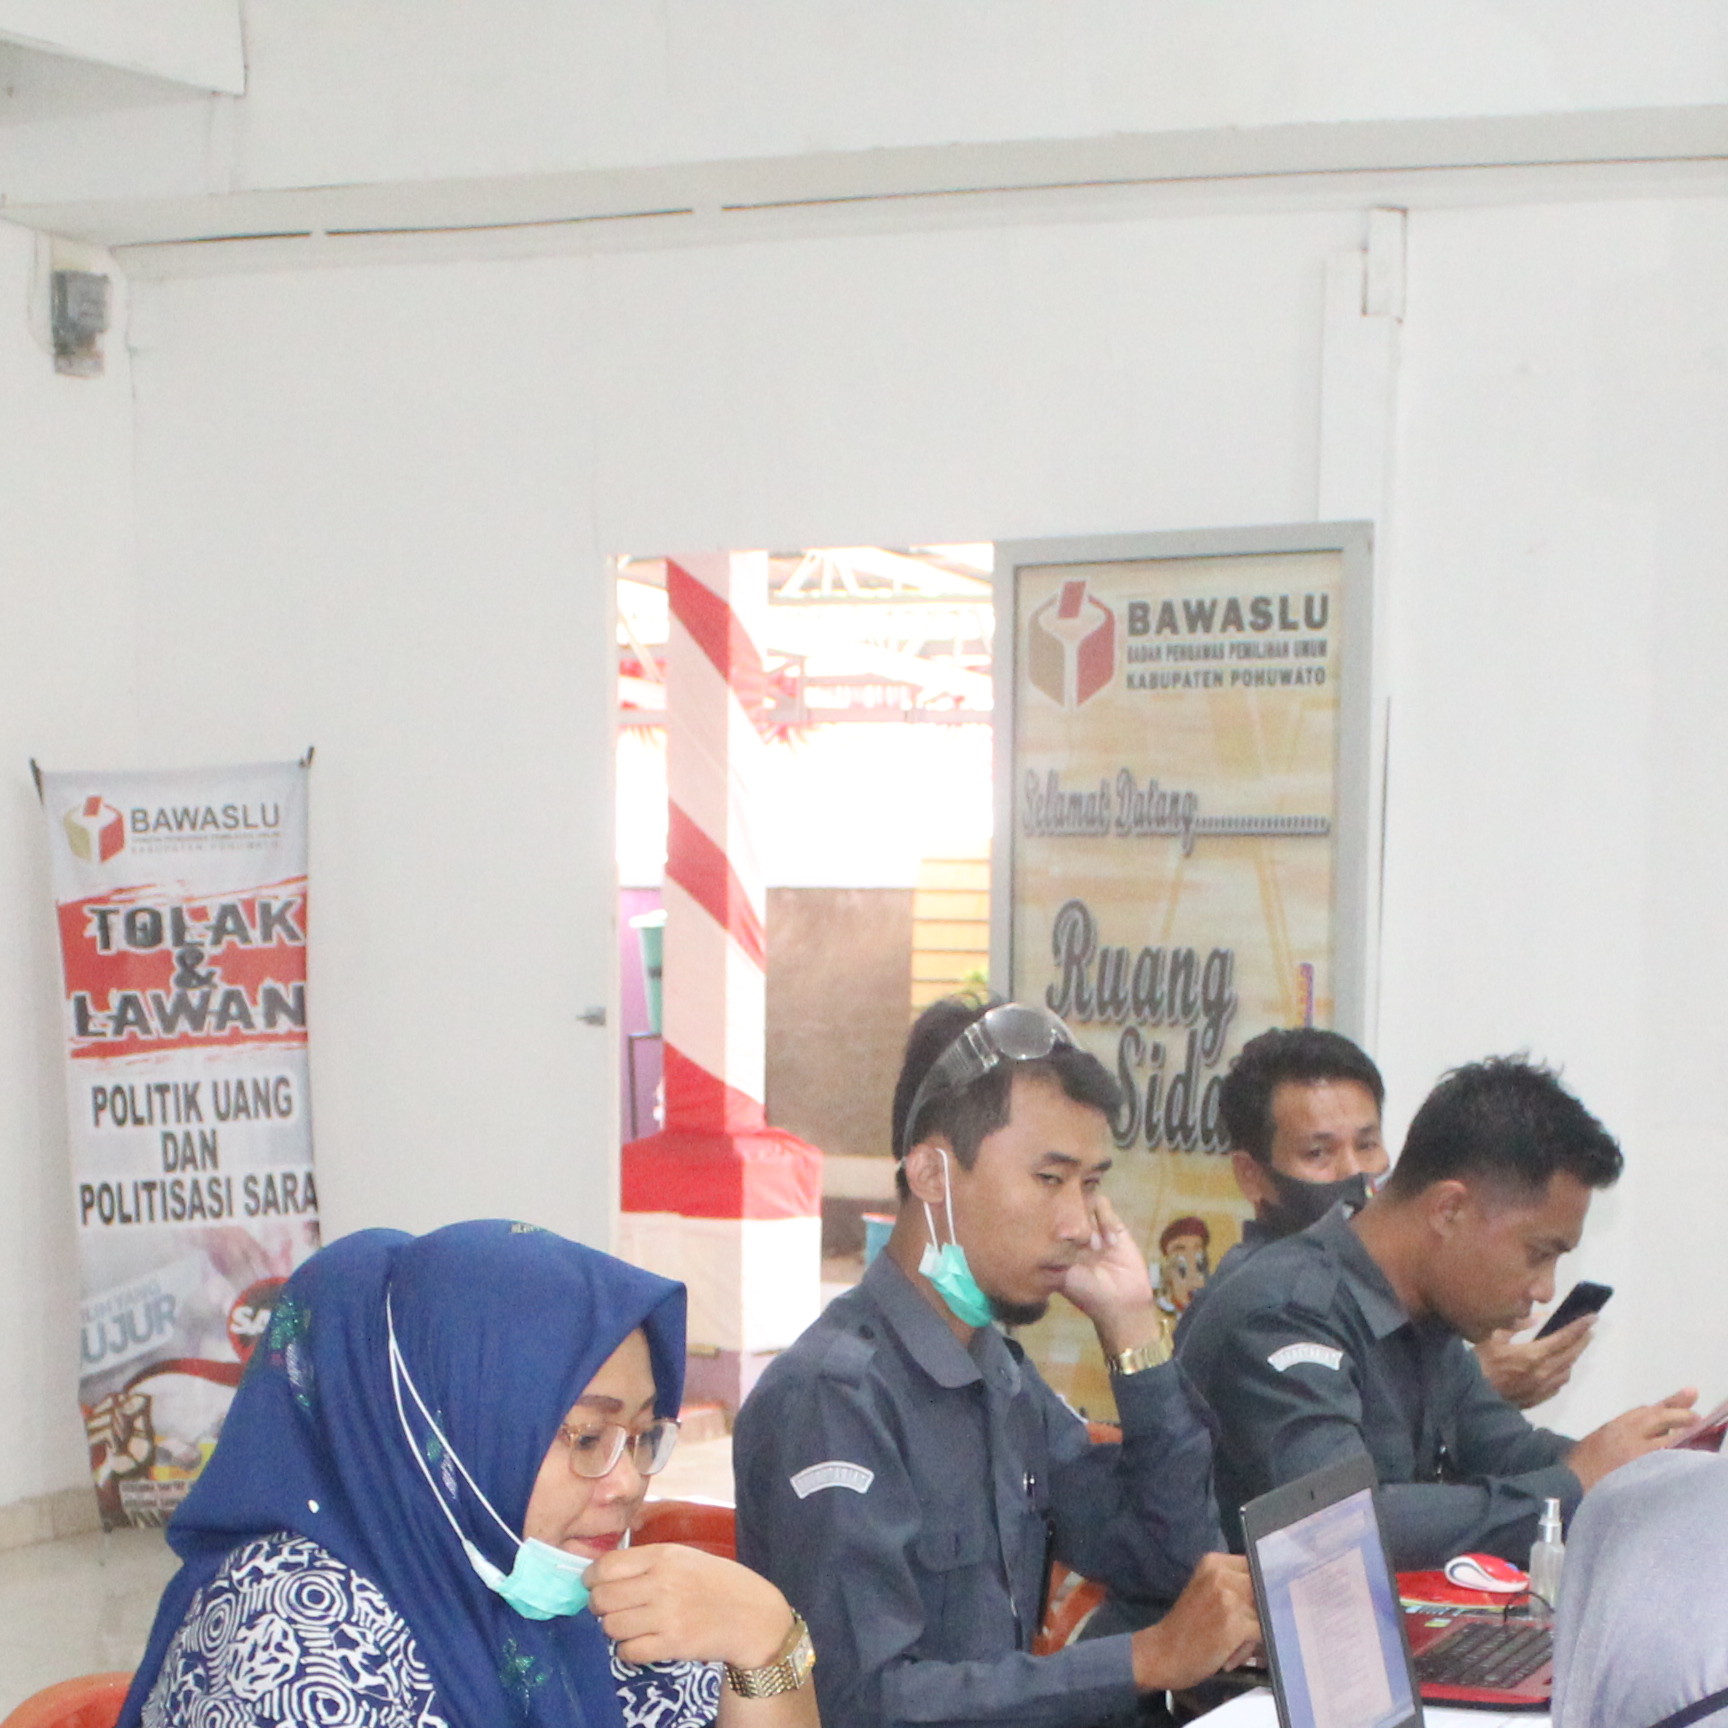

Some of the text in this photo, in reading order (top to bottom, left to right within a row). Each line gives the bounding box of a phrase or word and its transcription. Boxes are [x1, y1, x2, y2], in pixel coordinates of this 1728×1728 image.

[1128, 593, 1329, 637] BAWASLU
[1126, 665, 1326, 689] KABUPATEN POHUWATO
[130, 802, 280, 834] BAWASLU
[86, 900, 305, 951] TOLAK
[174, 941, 218, 989] &
[1047, 899, 1238, 1065] Ruang
[72, 984, 306, 1037] LAWAN
[91, 1074, 293, 1128] POLITIK UANG
[161, 1128, 219, 1173] DAN
[79, 1170, 319, 1226] POLITISASI SARA
